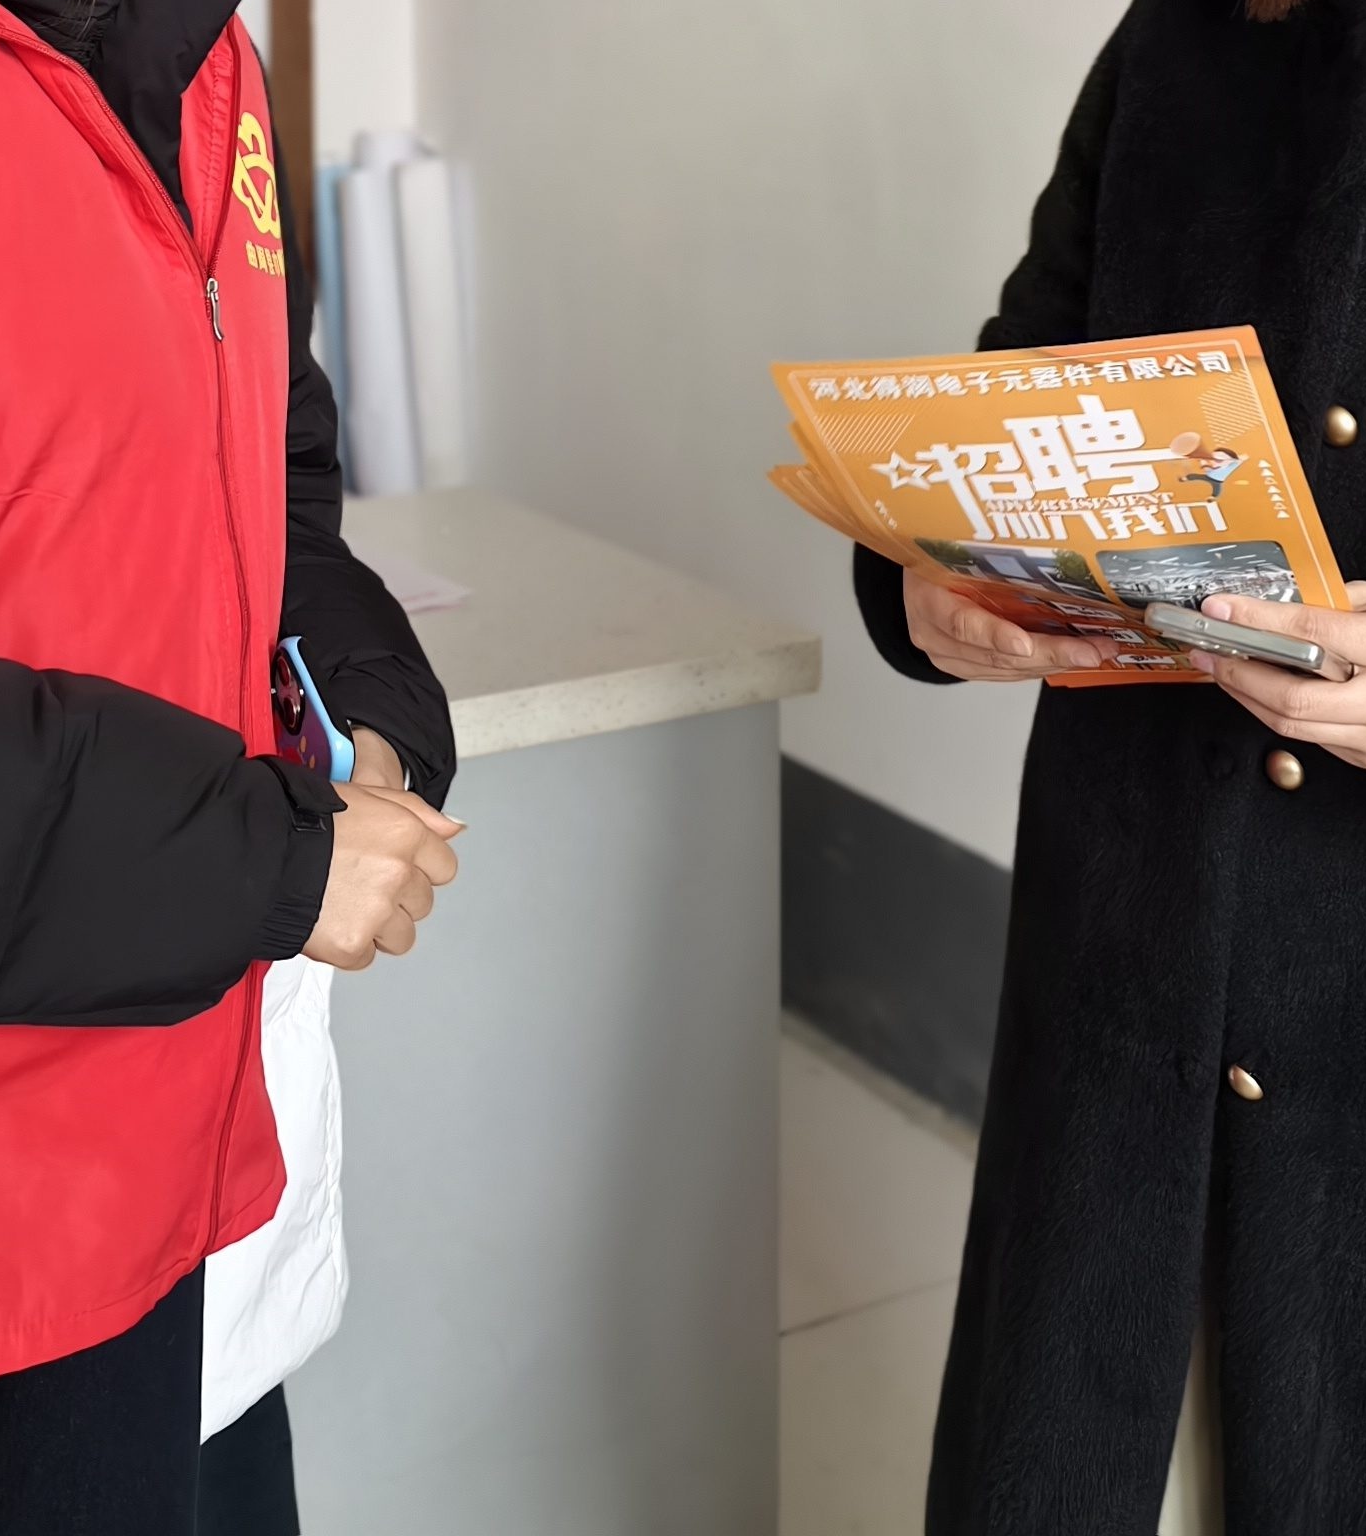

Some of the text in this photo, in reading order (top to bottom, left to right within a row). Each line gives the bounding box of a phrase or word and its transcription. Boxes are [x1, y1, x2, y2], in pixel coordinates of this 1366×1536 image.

[916, 394, 1175, 541] 招聘
[988, 500, 1227, 540] 加入我们
